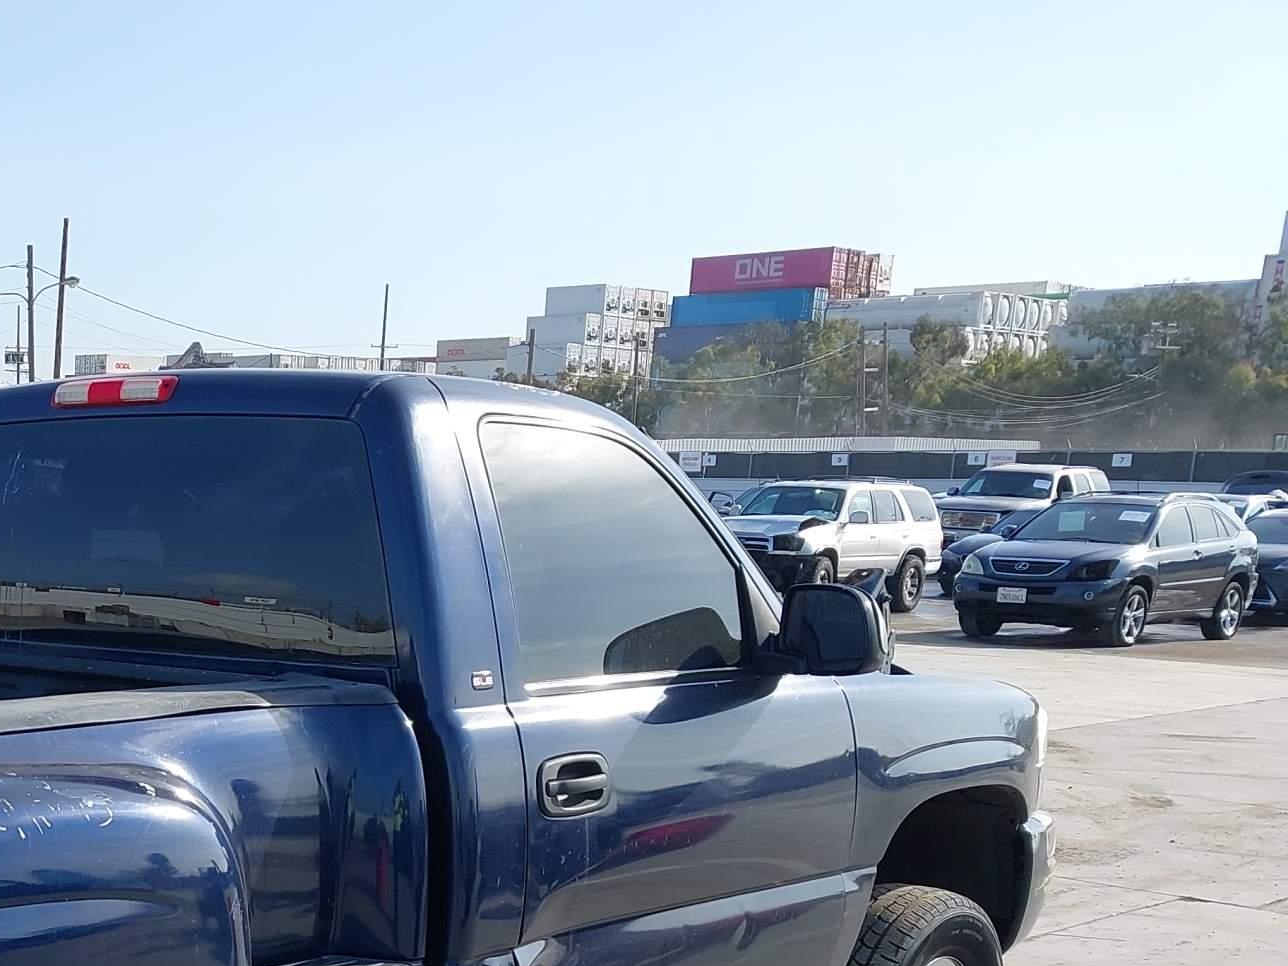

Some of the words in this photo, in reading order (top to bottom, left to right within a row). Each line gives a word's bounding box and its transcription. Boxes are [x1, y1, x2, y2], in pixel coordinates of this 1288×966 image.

[734, 255, 785, 280] ONE
[974, 455, 980, 463] 6
[1119, 456, 1125, 464] 7
